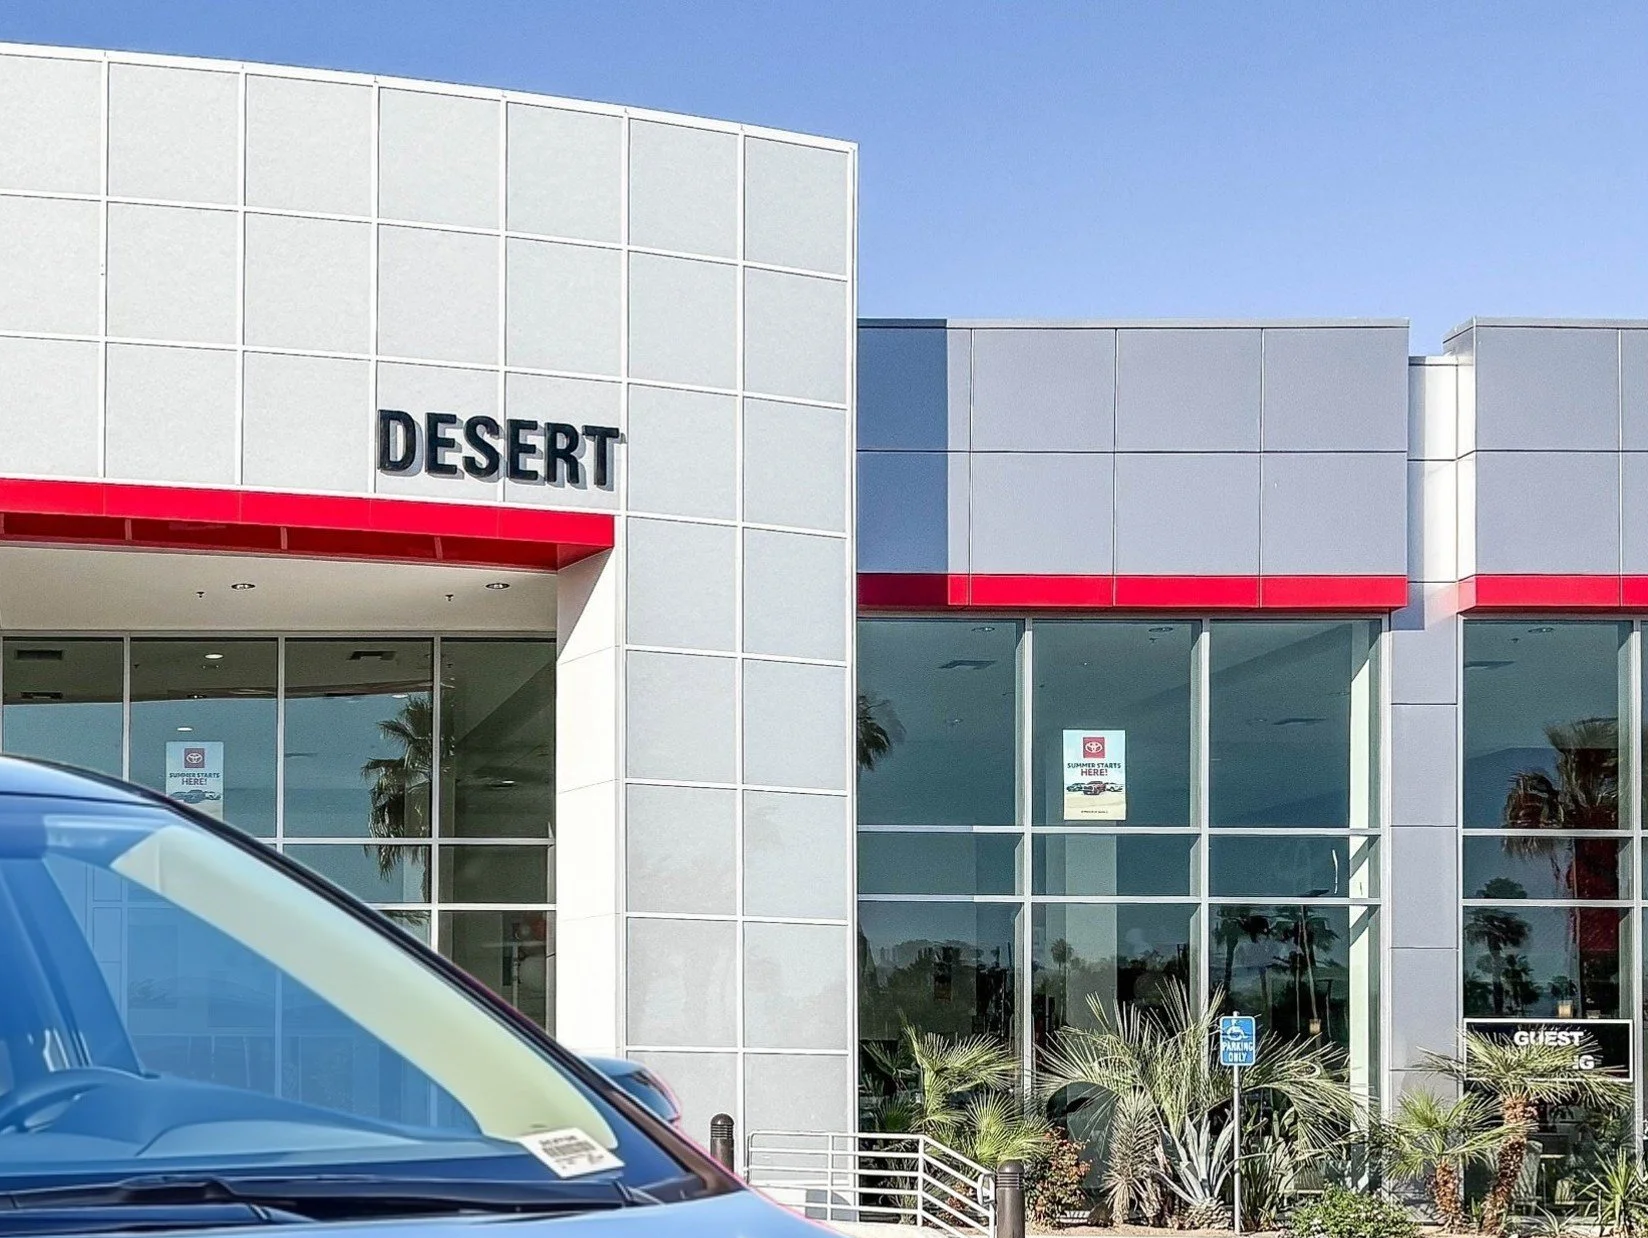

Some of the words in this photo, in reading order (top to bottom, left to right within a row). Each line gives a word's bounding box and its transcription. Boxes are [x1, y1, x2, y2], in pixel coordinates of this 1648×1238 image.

[377, 409, 621, 487] DESERT
[1080, 768, 1108, 776] HERE!
[181, 778, 207, 786] HERE!
[1513, 1031, 1584, 1046] GUEST
[1222, 1041, 1254, 1052] PARKING
[1228, 1052, 1248, 1062] ONLY
